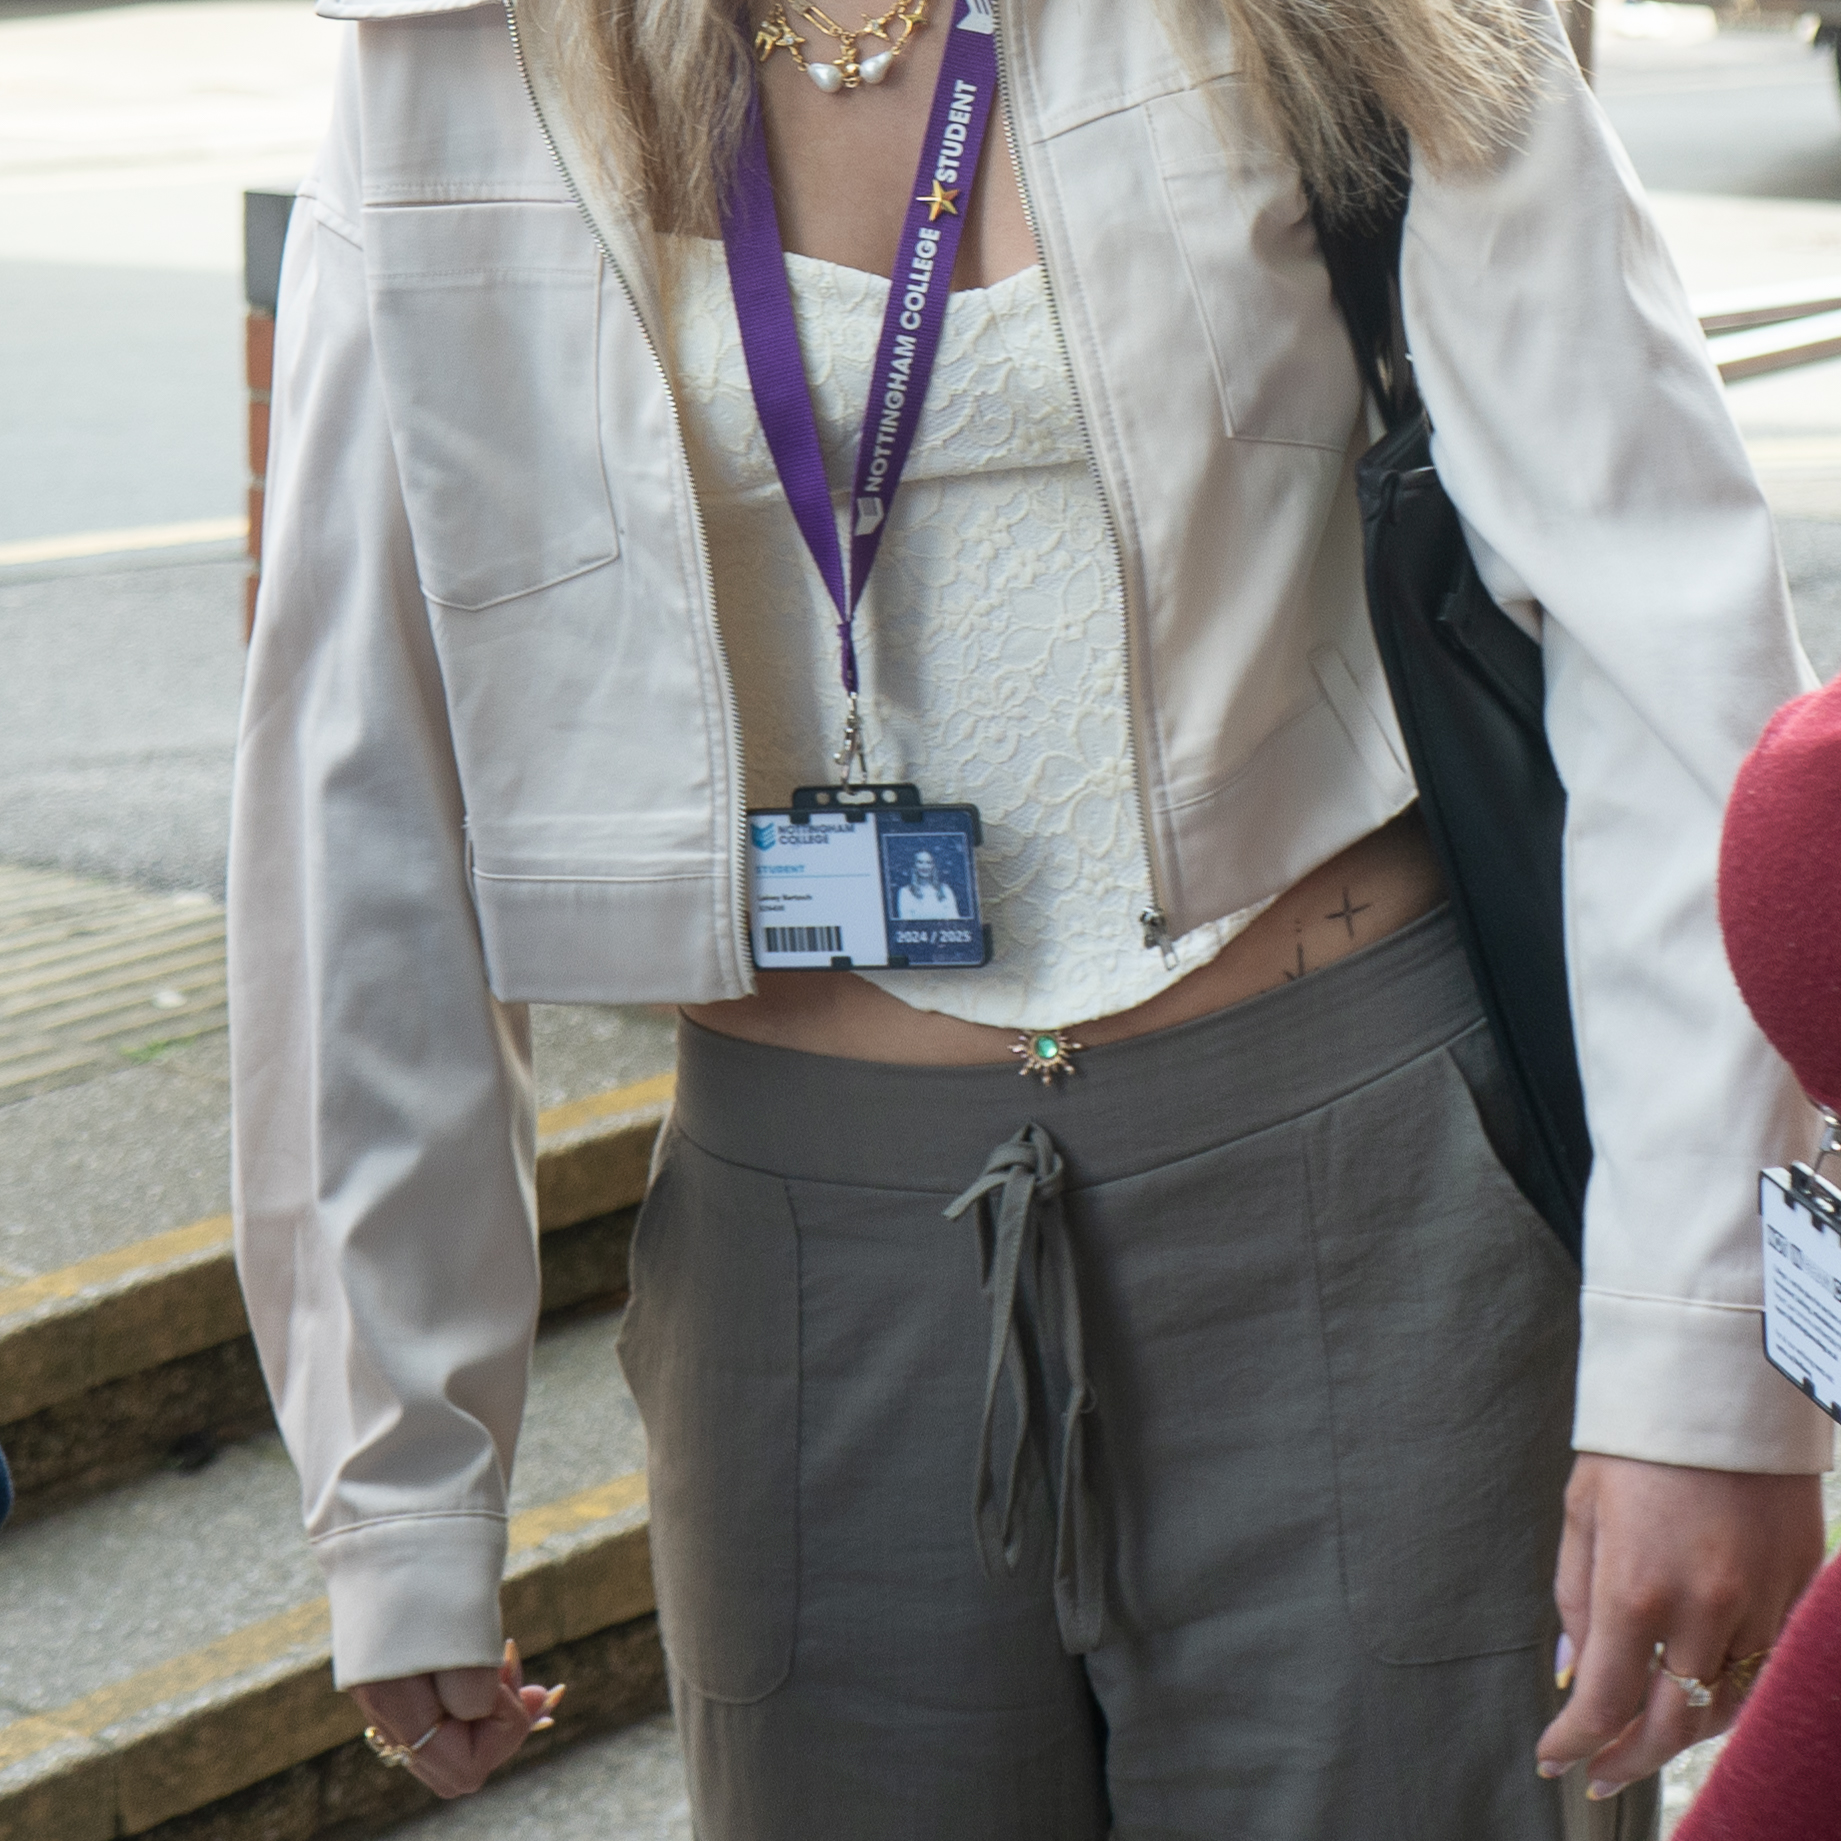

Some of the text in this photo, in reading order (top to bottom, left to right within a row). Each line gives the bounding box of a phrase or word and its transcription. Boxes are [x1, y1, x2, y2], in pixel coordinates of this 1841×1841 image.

[935, 79, 978, 185] STUDENT
[864, 226, 942, 493] NOTTINGHAM COLLEGE
[779, 834, 830, 845] COLLEGE
